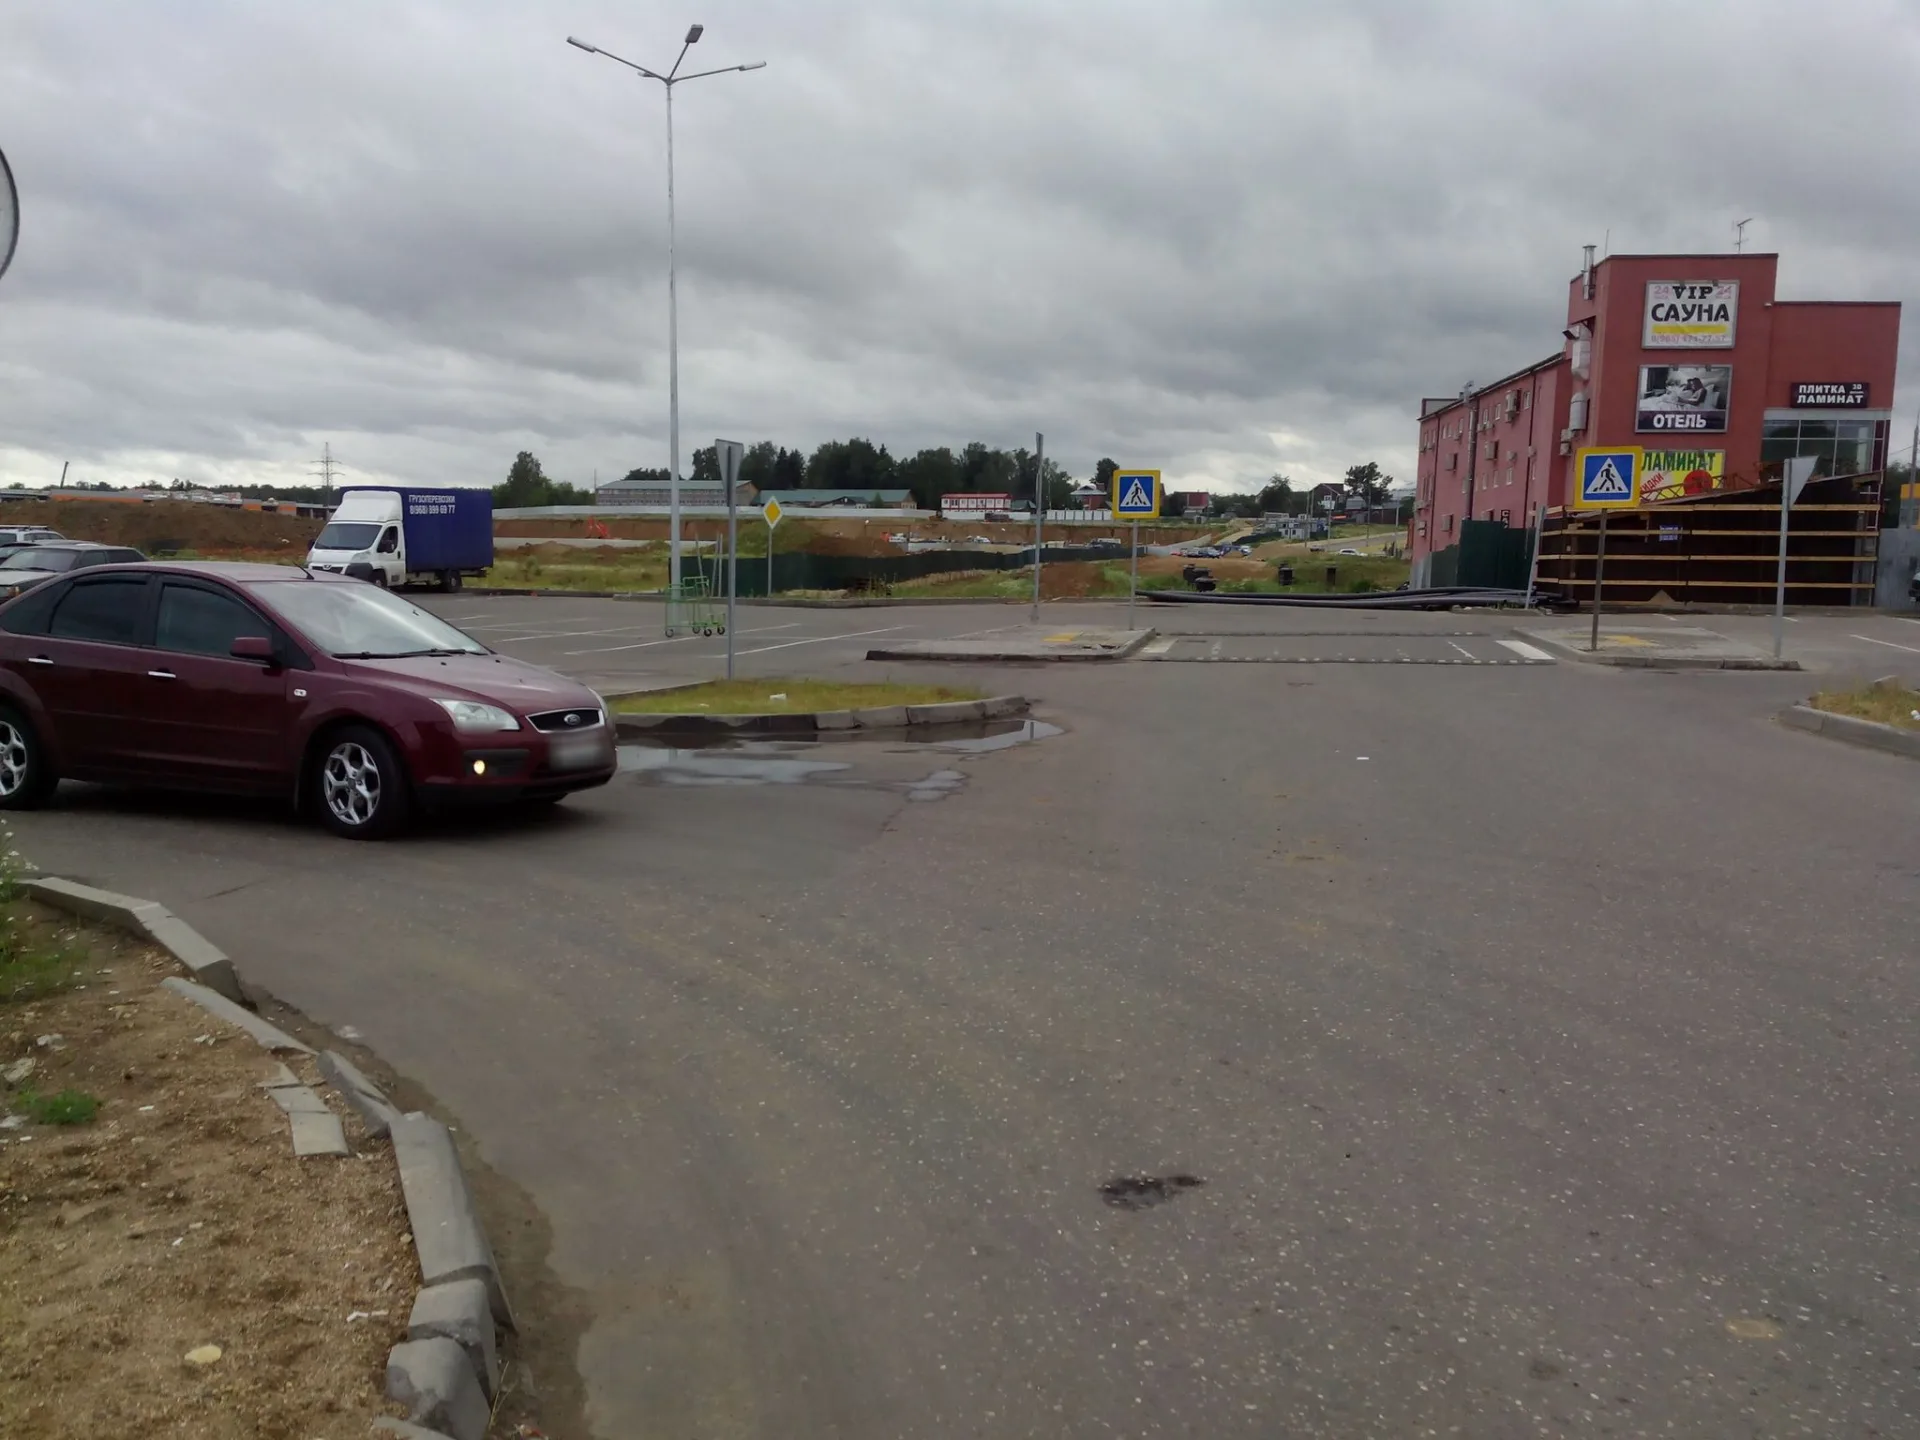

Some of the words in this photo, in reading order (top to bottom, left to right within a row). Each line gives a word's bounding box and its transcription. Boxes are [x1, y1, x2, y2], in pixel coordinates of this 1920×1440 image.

[1672, 286, 1713, 300] VIP
[1651, 303, 1730, 322] САУНА
[1799, 384, 1846, 394] ПЛИТКА
[1796, 394, 1864, 404] ЛАМИНАТ
[1653, 413, 1707, 429] ОТЕЛЬ
[1641, 451, 1716, 472] ЛАМИНАТ
[408, 494, 456, 504] ГРУЗОПЕРЕВОЗКИ
[447, 504, 456, 514] 77
